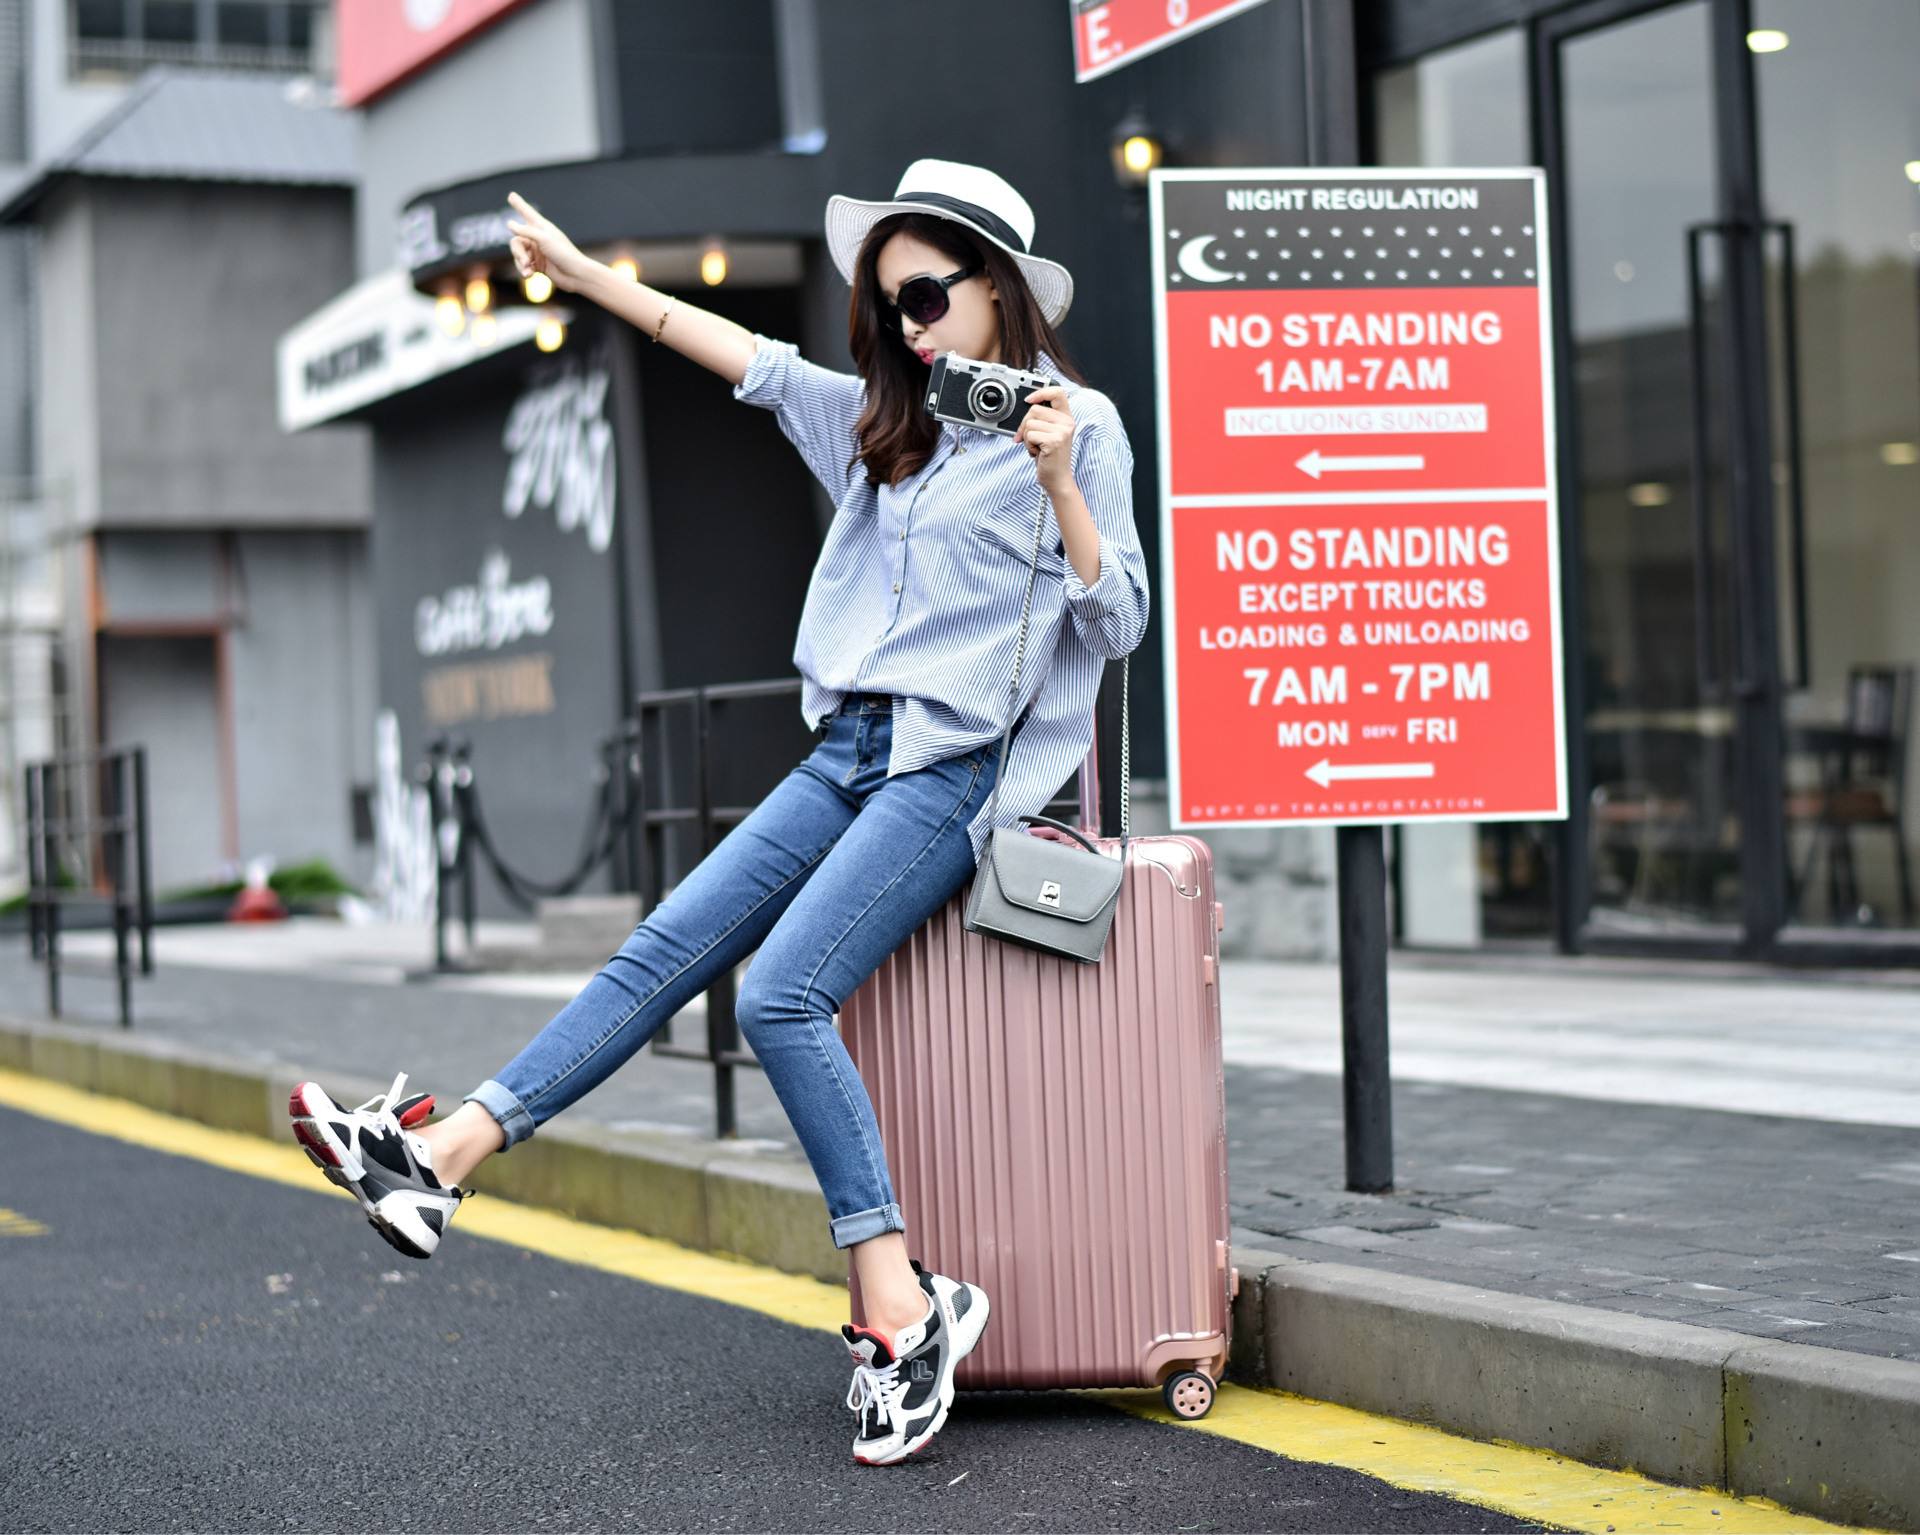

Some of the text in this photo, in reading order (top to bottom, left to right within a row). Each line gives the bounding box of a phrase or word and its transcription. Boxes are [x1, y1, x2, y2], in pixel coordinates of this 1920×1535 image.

[1226, 187, 1479, 211] NIGHT REGULATION
[1209, 311, 1502, 348] NO STANDING
[1256, 356, 1450, 392] 1AM-7AM
[1380, 409, 1483, 431] SUNDAY
[1216, 525, 1509, 572] NO STANDING
[1239, 578, 1487, 613] EXCEPT TRUCKS
[1199, 618, 1530, 650] LOADING & UNLOADING
[1243, 661, 1490, 706] 7AM - 7PM
[1277, 720, 1349, 747] MON
[1407, 717, 1457, 743] FRI
[1190, 797, 1485, 818] DEPT OF TRANSPORTATION
